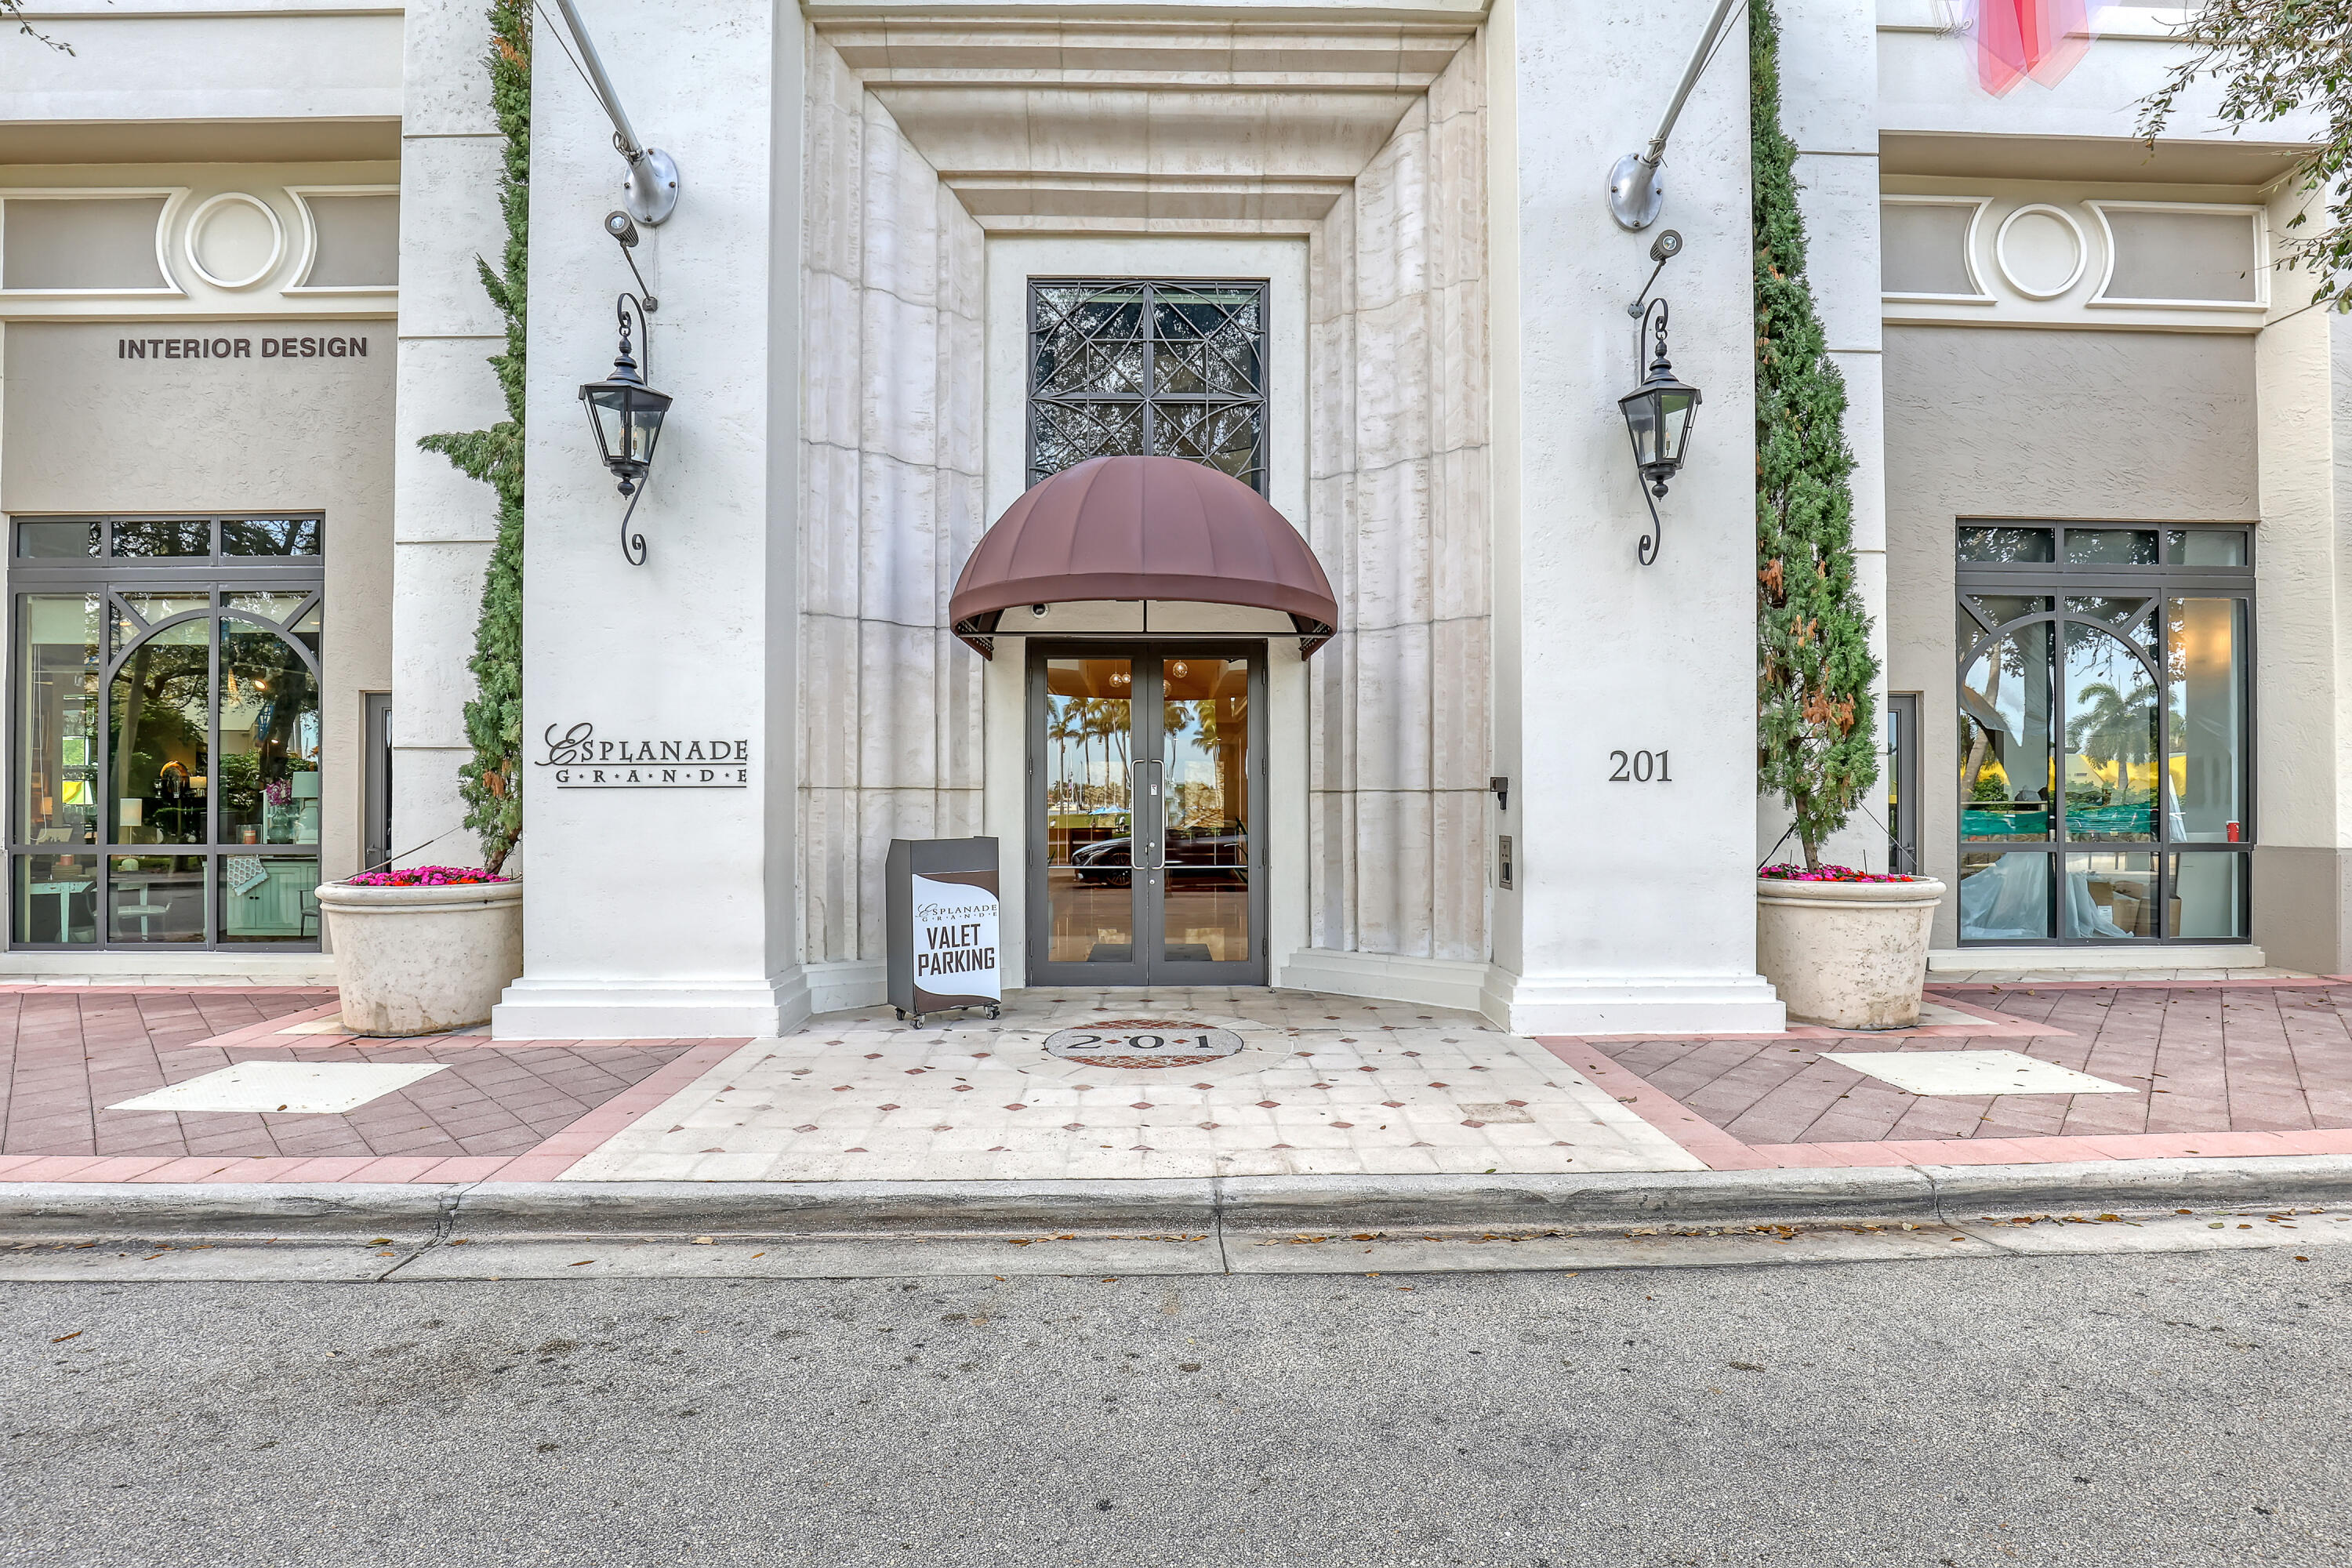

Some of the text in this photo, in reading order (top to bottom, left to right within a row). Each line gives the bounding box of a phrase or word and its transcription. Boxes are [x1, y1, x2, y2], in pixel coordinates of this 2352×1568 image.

[118, 337, 368, 358] INTERIOR DESIGN
[534, 722, 748, 766] ESPLANADE
[1609, 750, 1672, 782] 201
[915, 903, 997, 917] ESPLANADE
[927, 924, 981, 949] VALET
[918, 947, 995, 977] PARKING
